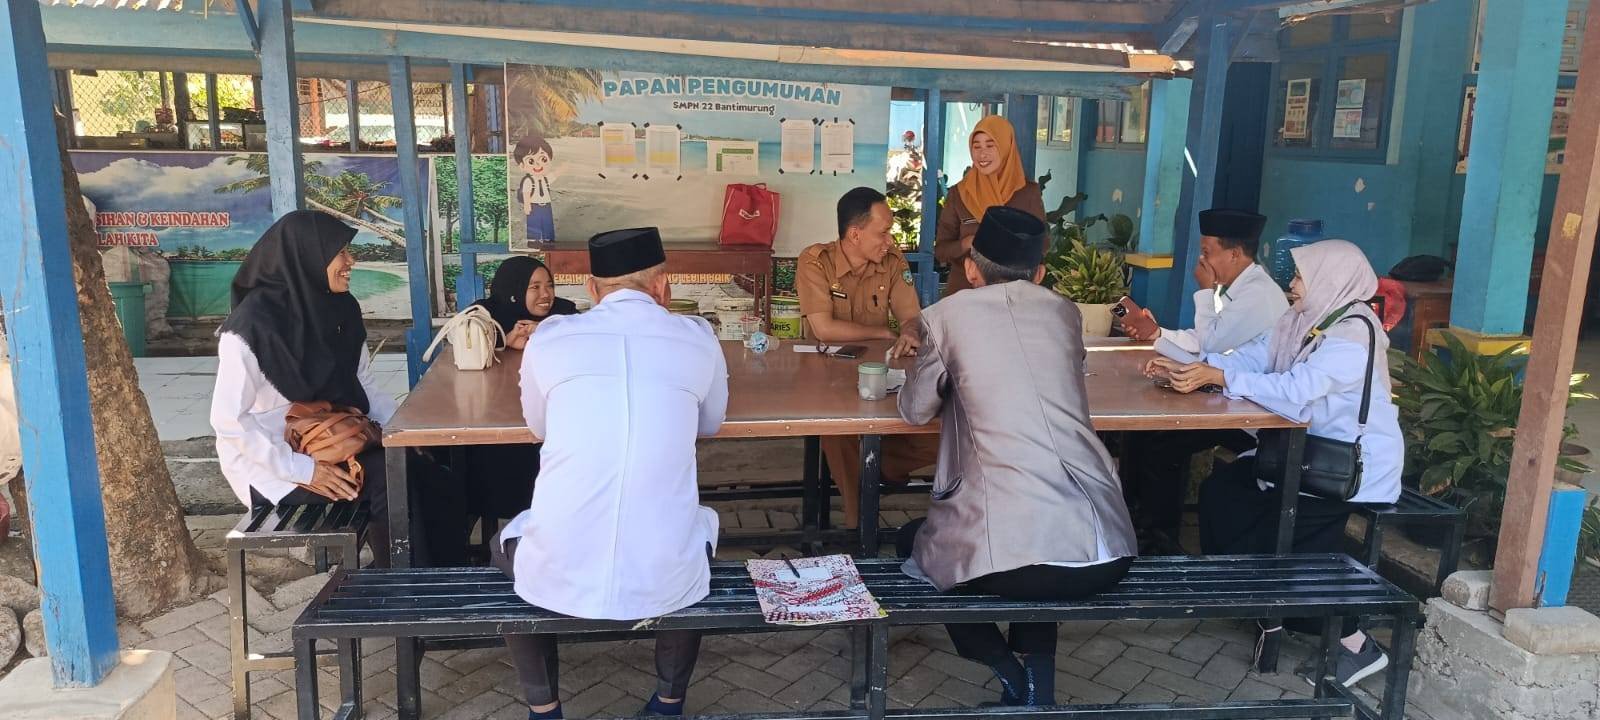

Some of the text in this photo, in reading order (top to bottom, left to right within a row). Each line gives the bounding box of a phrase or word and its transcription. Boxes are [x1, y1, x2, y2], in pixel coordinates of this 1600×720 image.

[603, 78, 841, 105] PAPAN PENGUMUMAN
[673, 101, 775, 116] SMPN 22 Bantimurung
[138, 212, 148, 226] &
[150, 212, 230, 226] KEINDAHAN
[96, 232, 158, 247] LAH KITA
